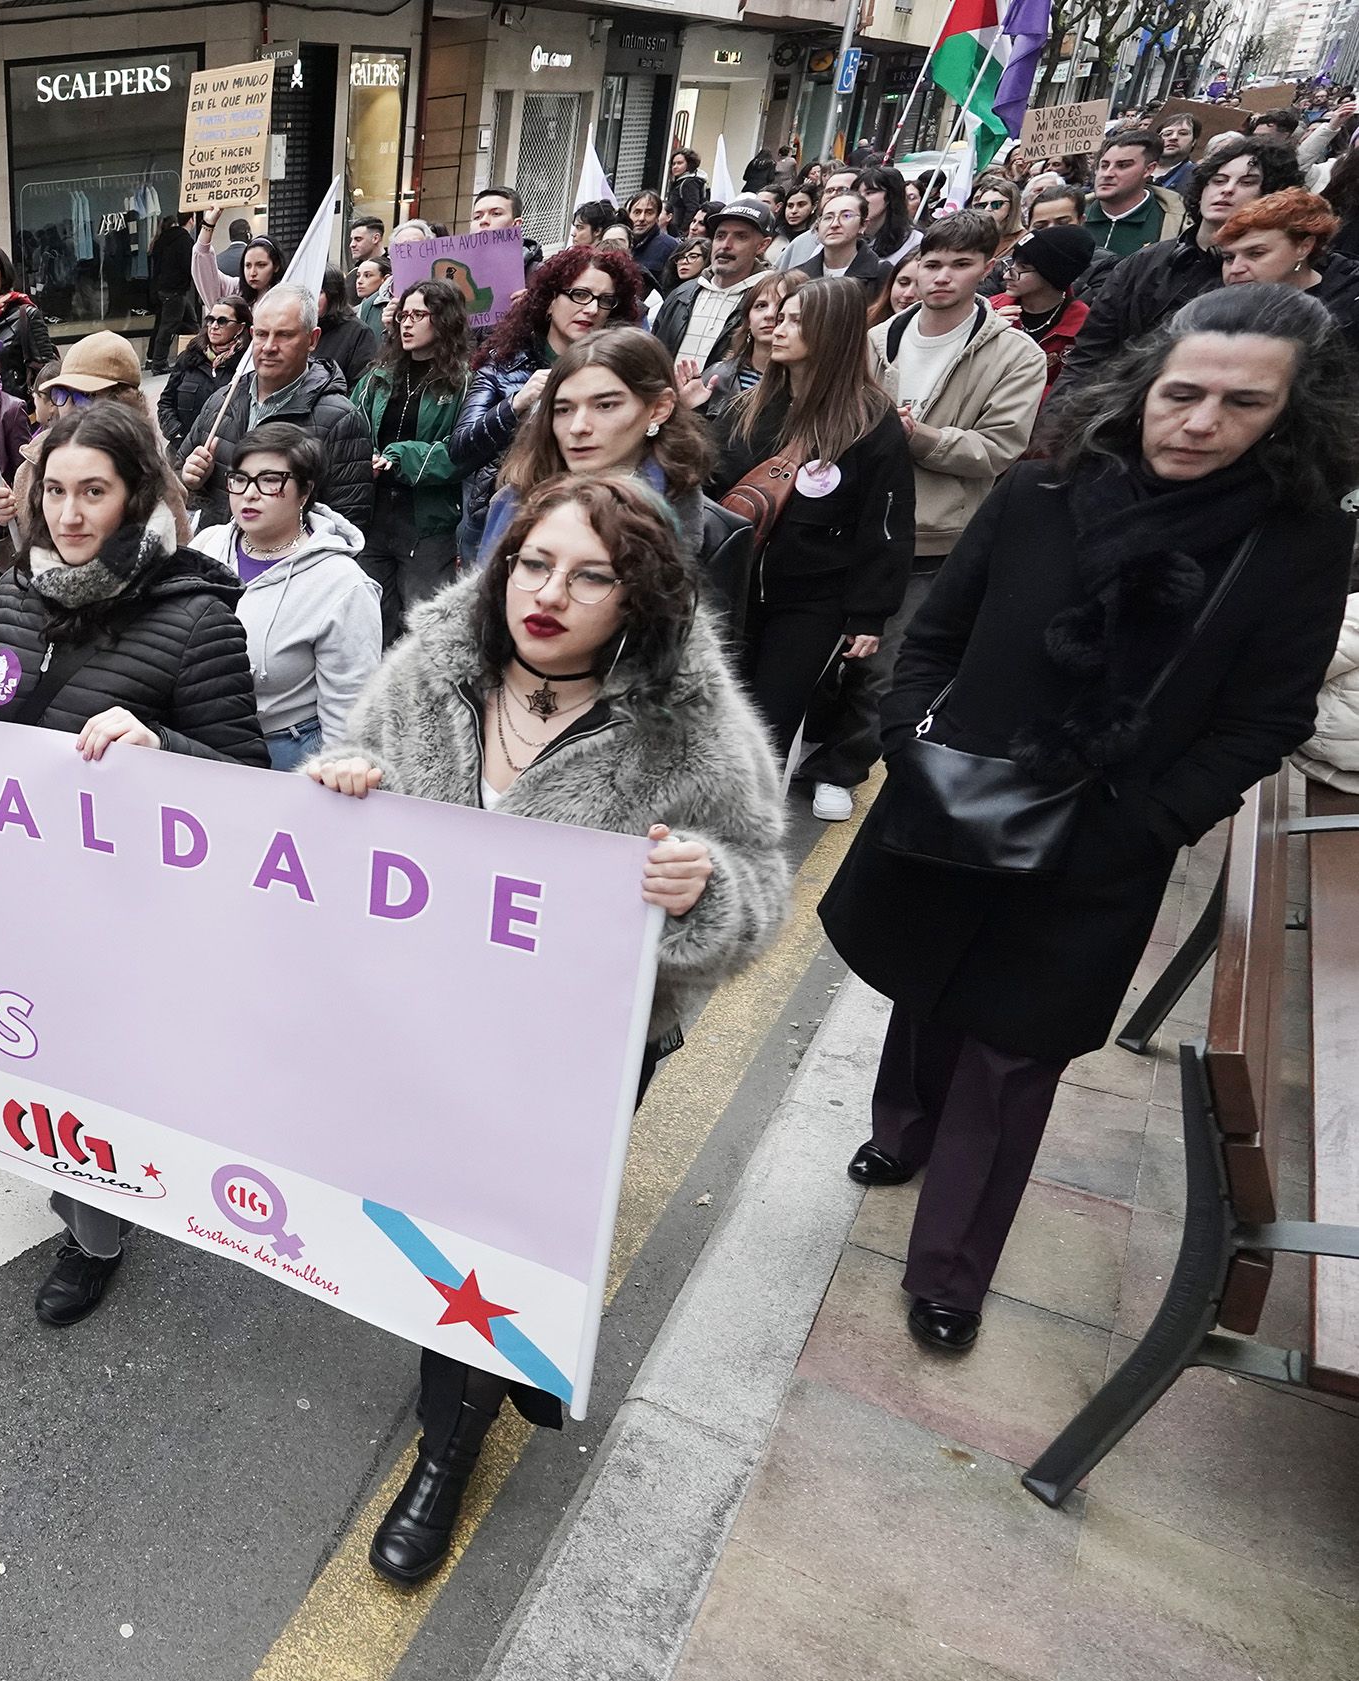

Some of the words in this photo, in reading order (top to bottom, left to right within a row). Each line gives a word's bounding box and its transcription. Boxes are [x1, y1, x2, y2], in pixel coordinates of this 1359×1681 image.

[261, 49, 293, 61] SCALPERS
[36, 65, 171, 103] SCALPERS
[194, 83, 207, 95] EN
[212, 80, 228, 92] UN
[232, 73, 268, 89] MUNDO
[192, 100, 204, 112] EN
[207, 98, 217, 110] EL
[221, 94, 241, 108] QUE
[245, 92, 267, 105] HAY
[1049, 107, 1065, 120] NO
[1068, 105, 1082, 118] ES
[1031, 133, 1044, 143] NO
[1047, 131, 1060, 141] ME
[1064, 125, 1102, 138] TOQUES
[221, 146, 252, 158] HACEN
[1049, 143, 1061, 154] EL
[1064, 139, 1091, 153] HIGO
[189, 166, 222, 181] TANTOS
[224, 161, 260, 177] HOMBRES
[185, 179, 222, 192] OPINANDO
[227, 175, 256, 186] SOBRE
[186, 193, 198, 203] EL
[208, 184, 260, 205] ABORTO?
[395, 244, 412, 259] PER
[419, 243, 437, 258] CHI
[442, 239, 455, 250] HA
[459, 232, 489, 250] AVUTO
[492, 229, 520, 244] PAURA
[3, 1099, 117, 1174] CIG
[52, 1161, 144, 1194] Correos
[228, 1184, 268, 1217] CIG
[254, 1245, 277, 1267] das
[282, 1264, 339, 1295] mulleres
